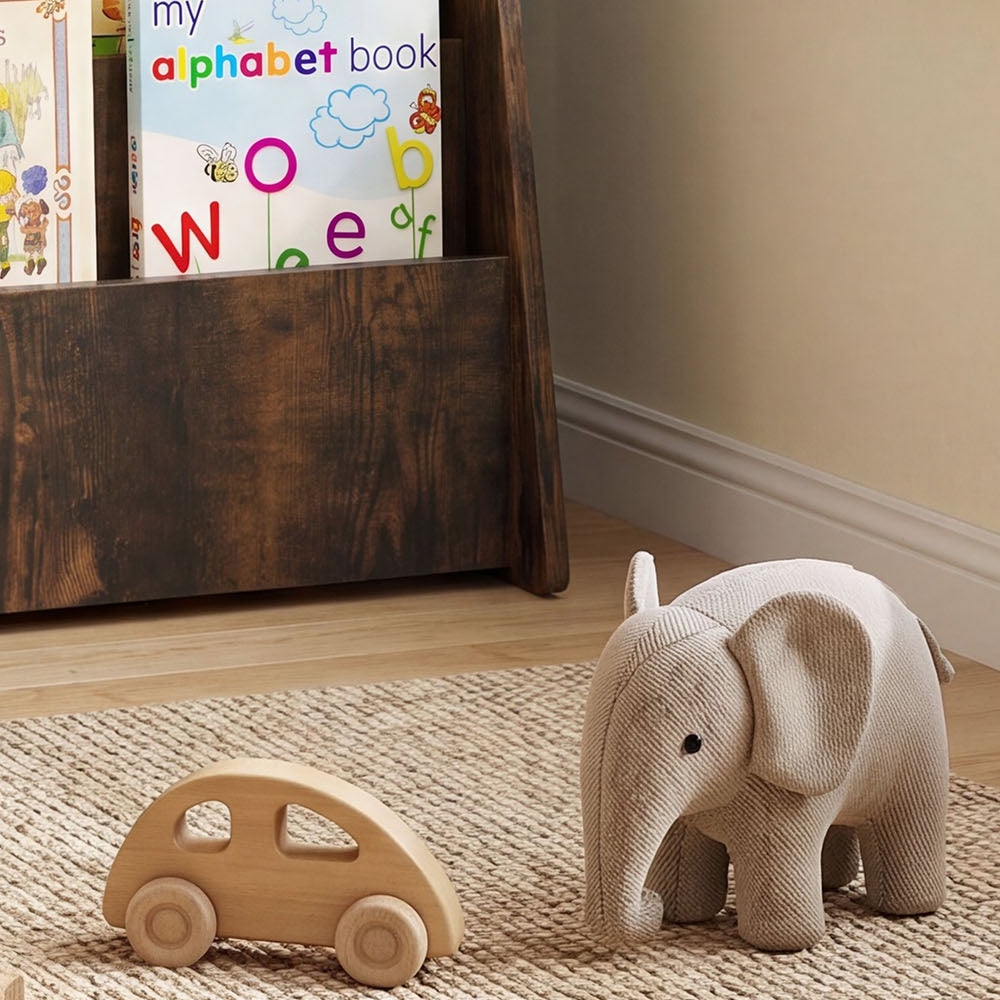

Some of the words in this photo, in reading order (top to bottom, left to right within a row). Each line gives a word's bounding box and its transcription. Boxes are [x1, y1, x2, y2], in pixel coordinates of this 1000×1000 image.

[153, 0, 204, 36] my
[152, 41, 338, 88] alphabet
[350, 33, 438, 72] book
